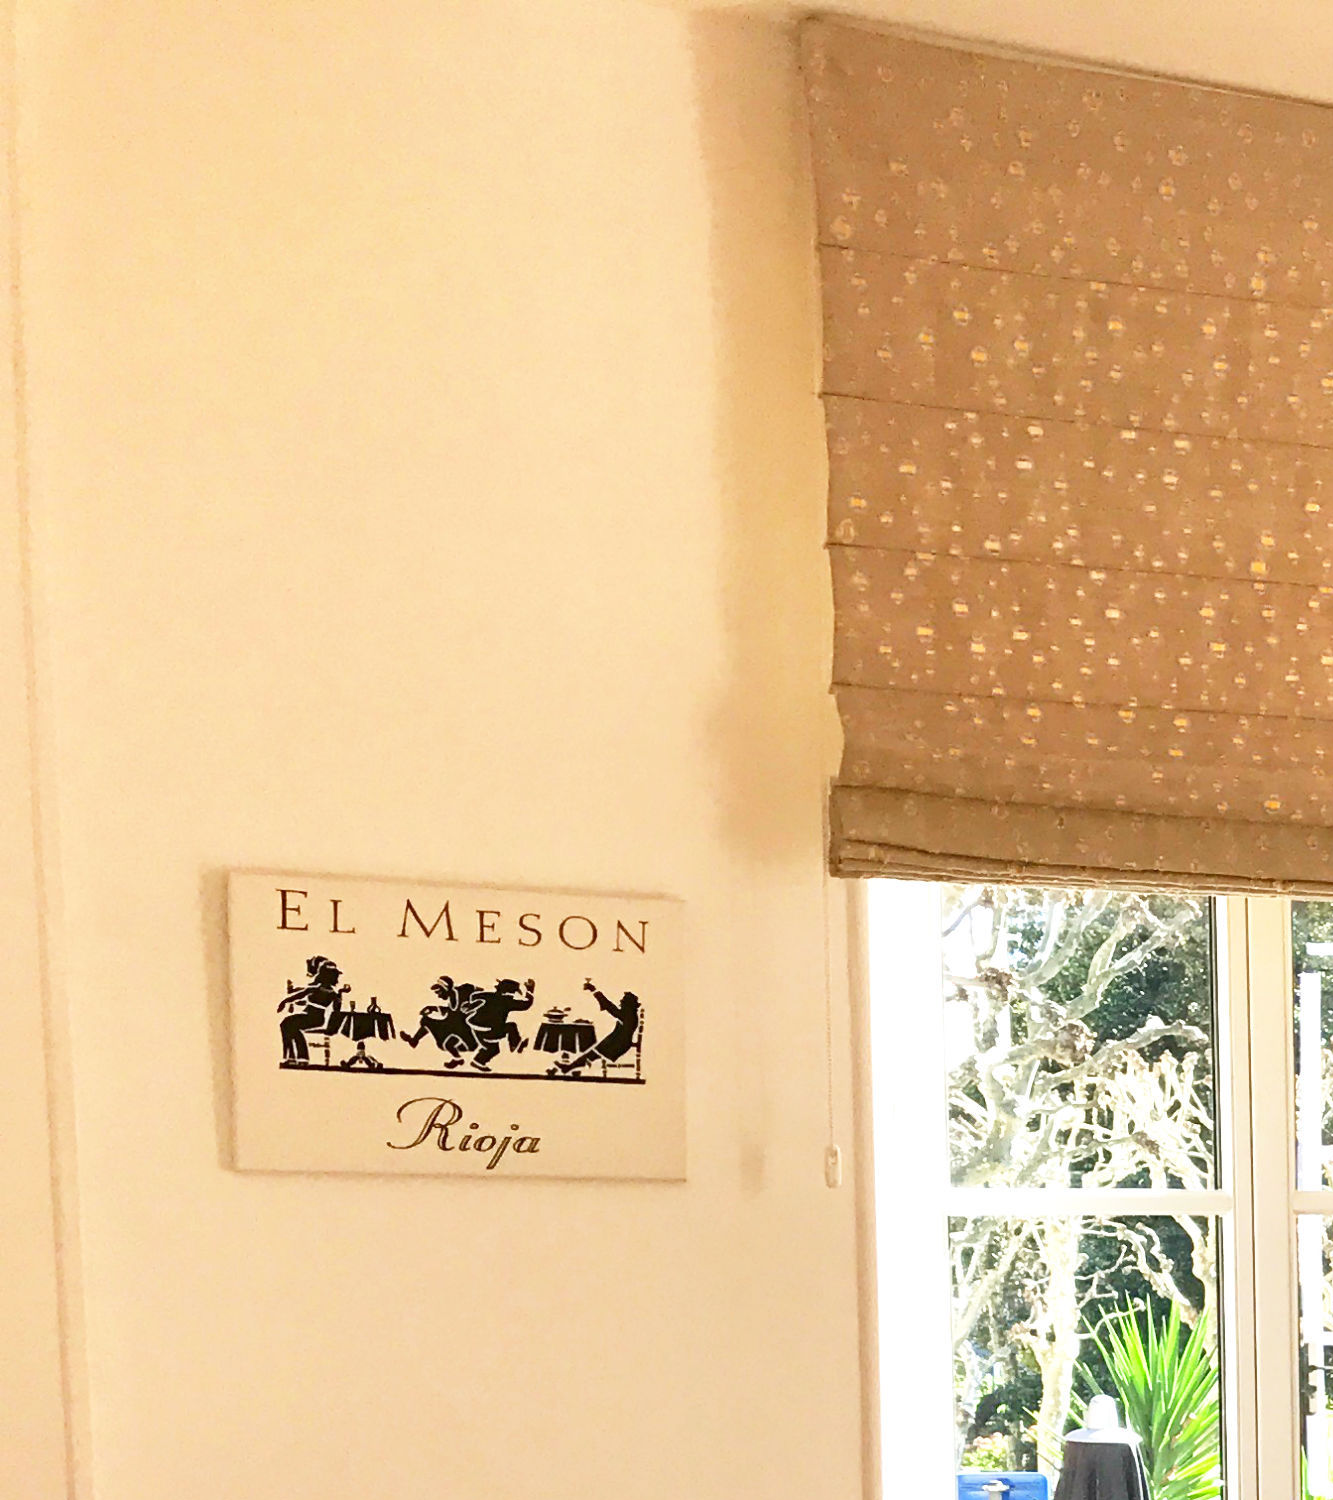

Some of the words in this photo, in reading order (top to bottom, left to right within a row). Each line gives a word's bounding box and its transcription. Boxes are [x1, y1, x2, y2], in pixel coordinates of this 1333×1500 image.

[276, 889, 356, 935] EL
[397, 898, 649, 953] MESON
[387, 1097, 540, 1170] Rioja
